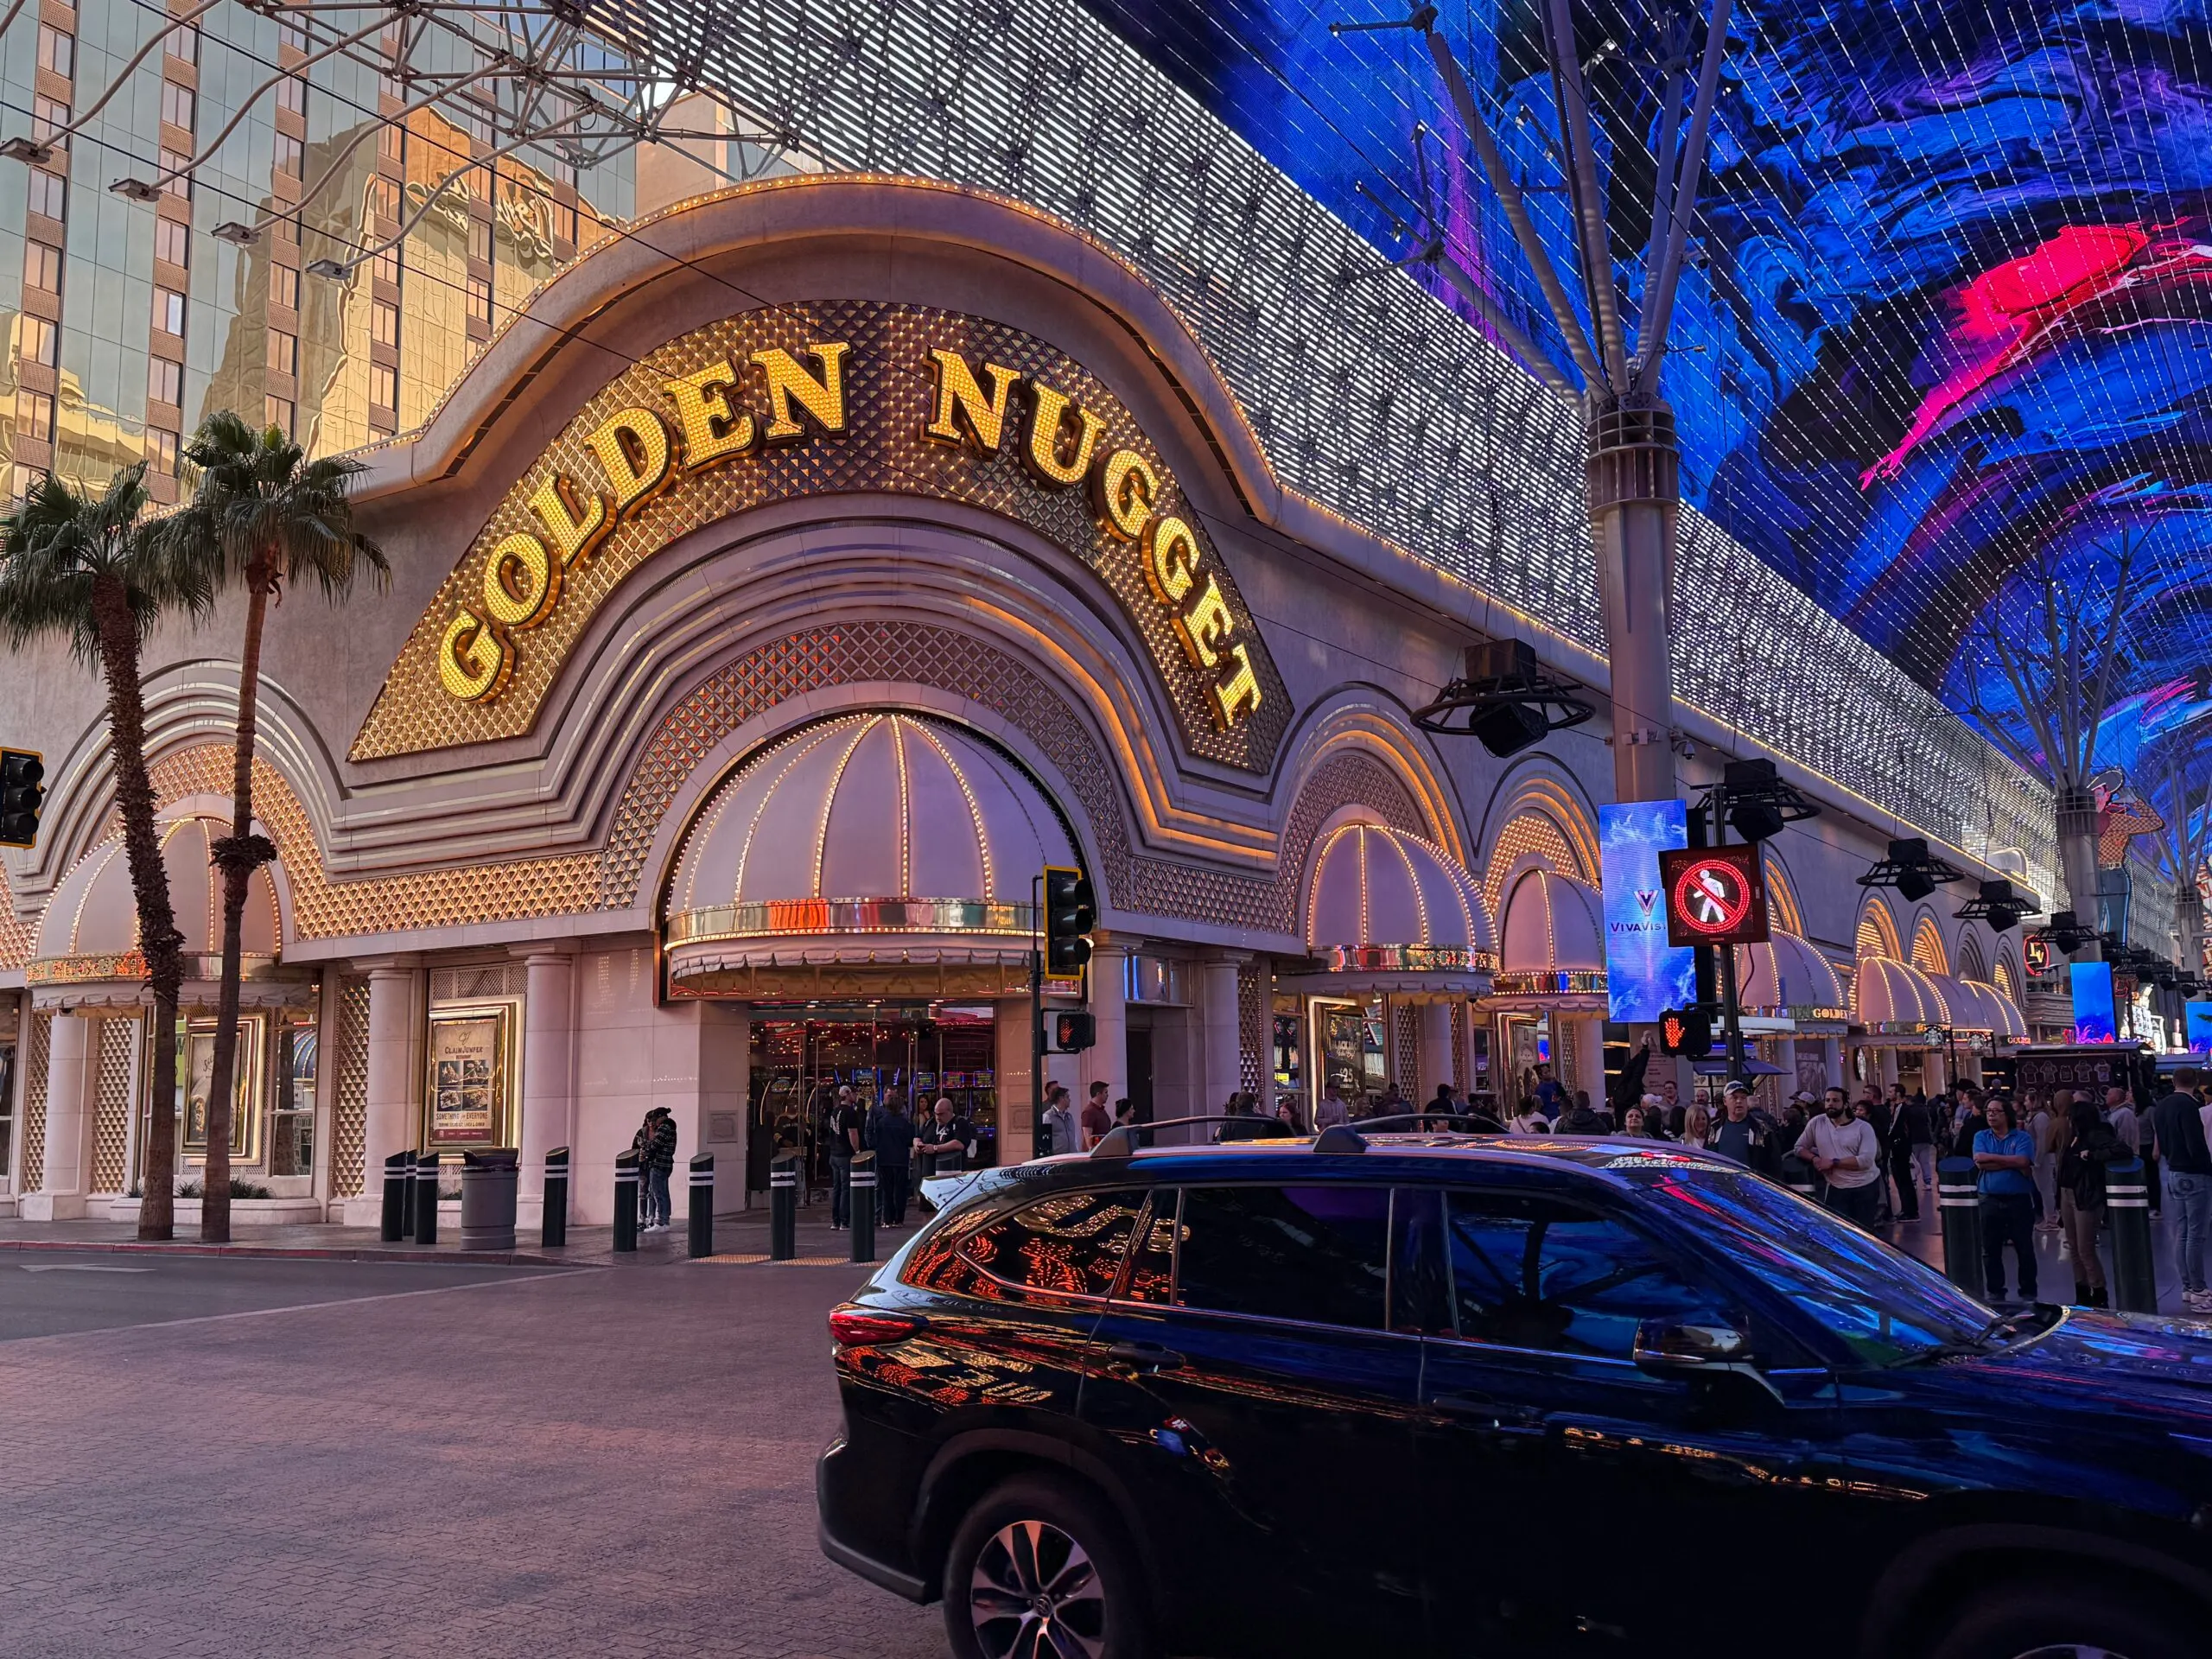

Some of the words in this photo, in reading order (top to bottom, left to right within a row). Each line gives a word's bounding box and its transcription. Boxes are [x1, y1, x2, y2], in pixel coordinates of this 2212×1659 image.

[438, 341, 851, 702] GOLDEN
[921, 347, 1262, 728] NUGGET
[467, 1111, 488, 1120] EVERYONE
